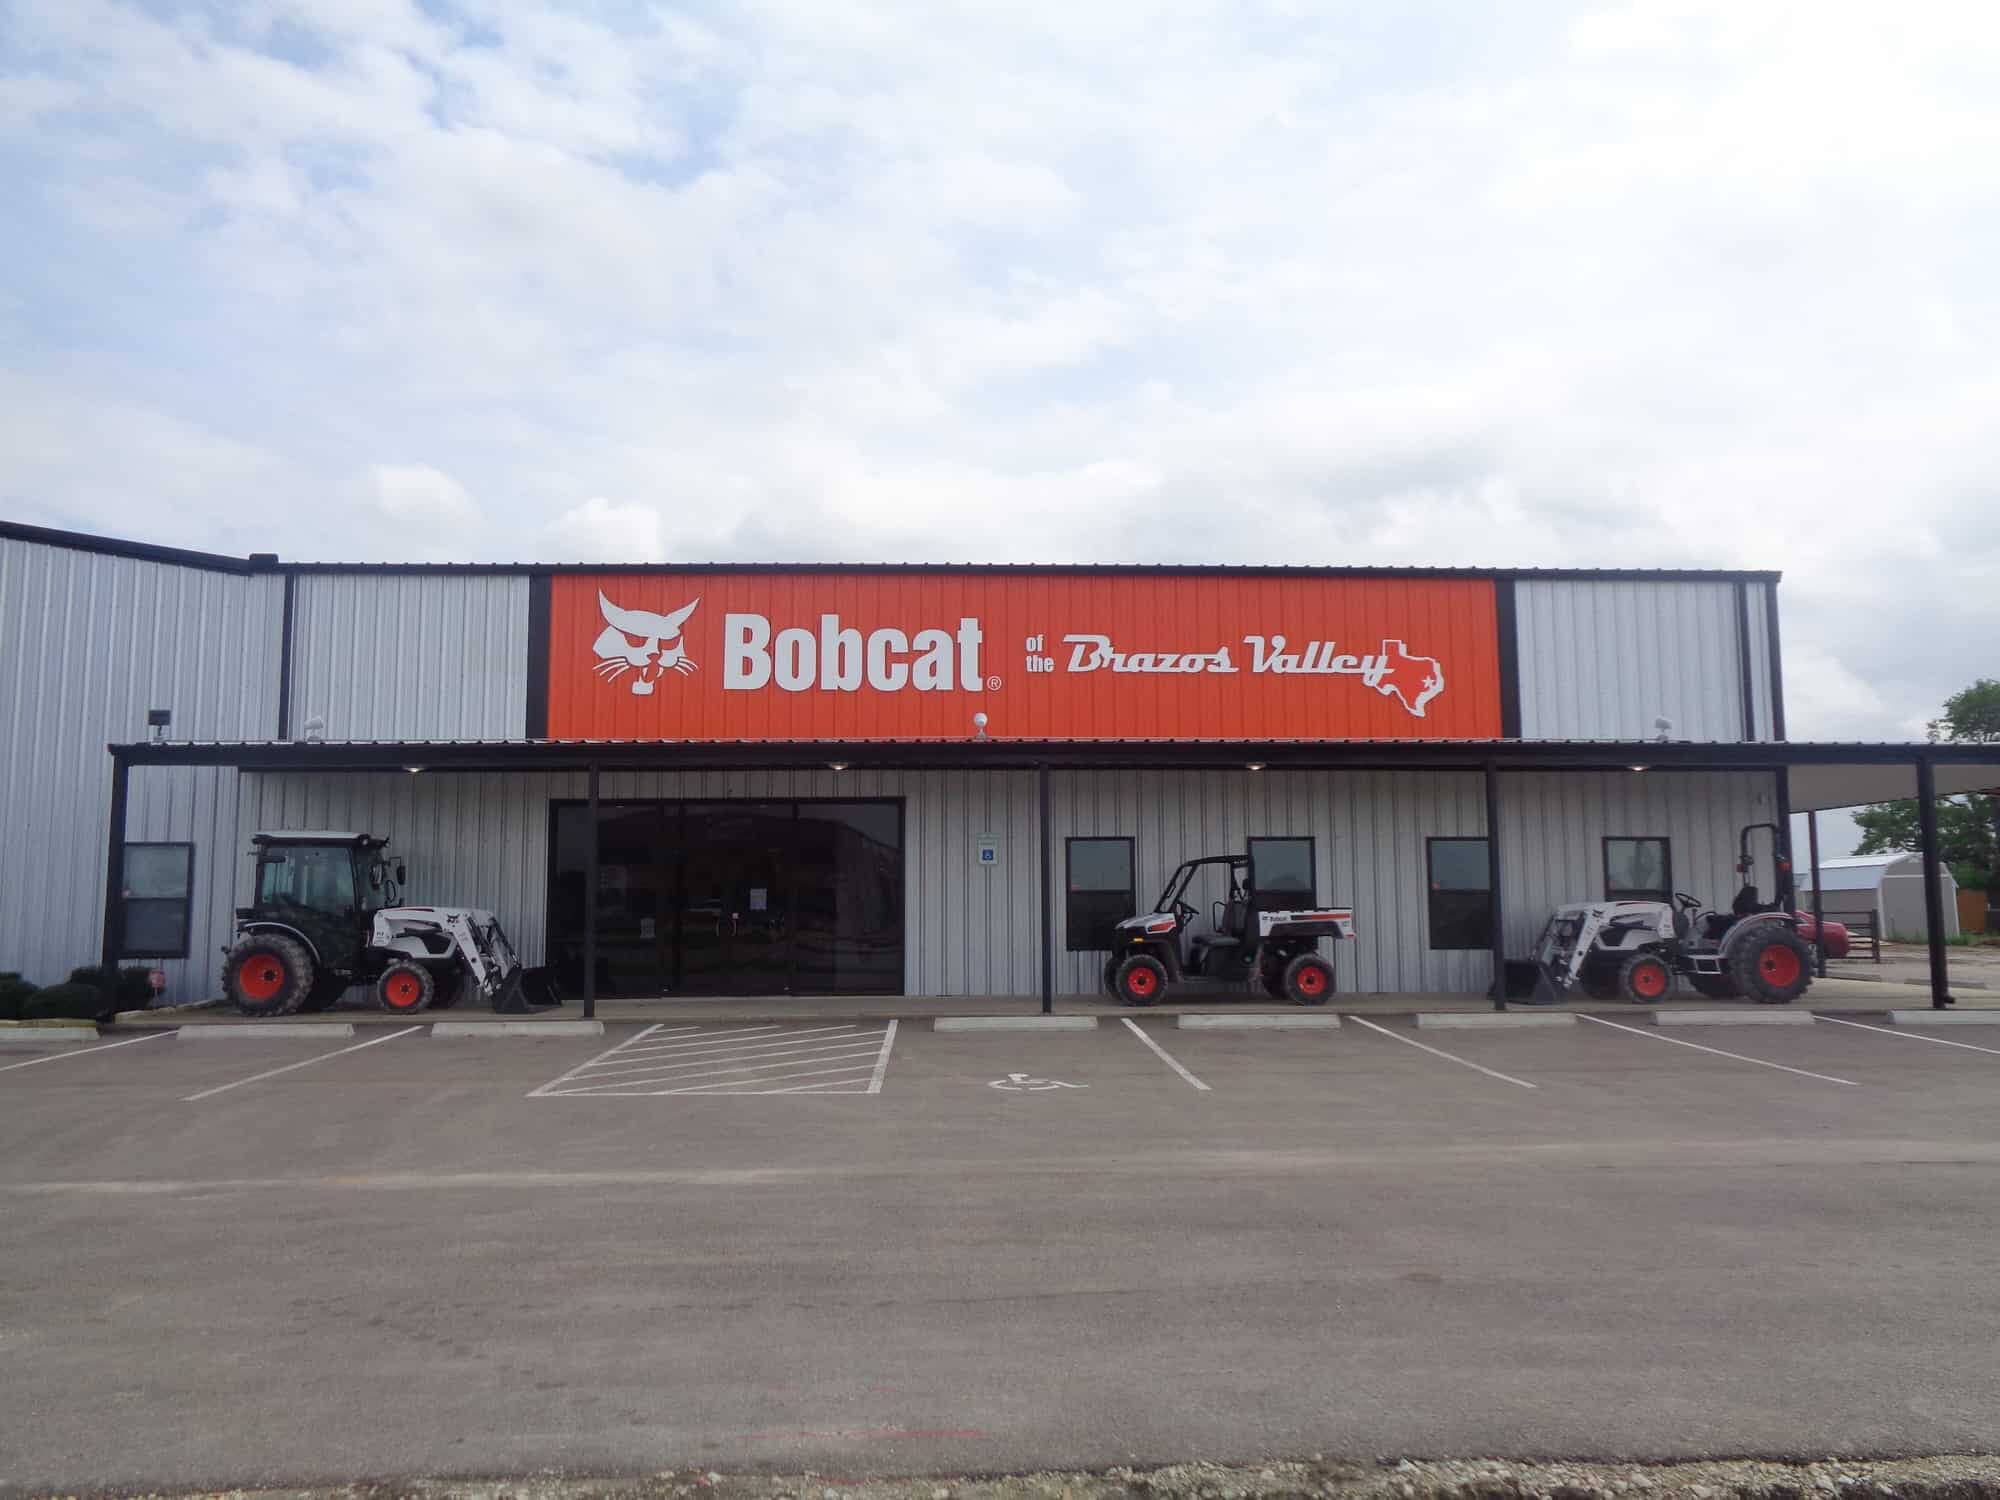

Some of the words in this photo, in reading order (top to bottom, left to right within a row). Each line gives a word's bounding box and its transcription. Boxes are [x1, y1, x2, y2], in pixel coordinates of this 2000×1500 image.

[723, 613, 983, 692] Bobcat
[1026, 634, 1044, 652] of
[1063, 634, 1239, 673] Brazos
[1243, 635, 1395, 687] Valley
[1026, 654, 1055, 673] the
